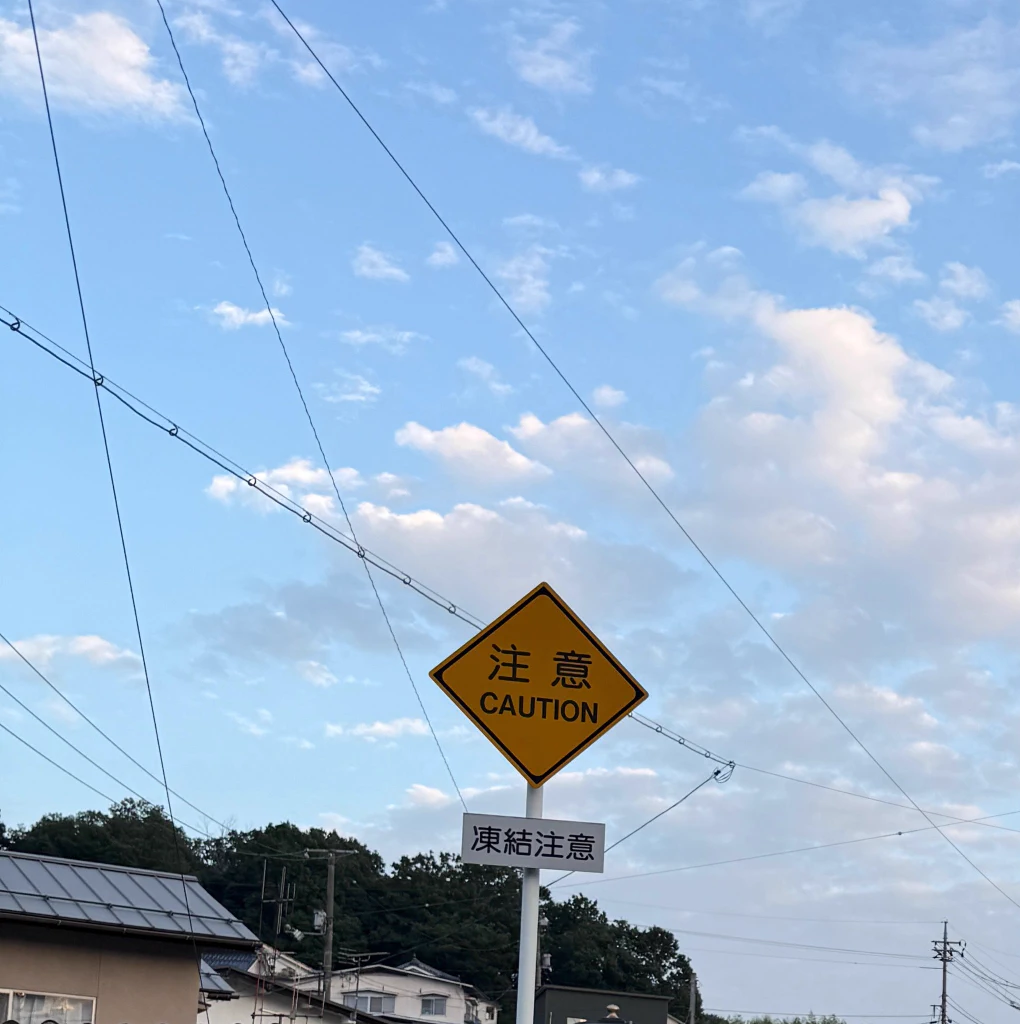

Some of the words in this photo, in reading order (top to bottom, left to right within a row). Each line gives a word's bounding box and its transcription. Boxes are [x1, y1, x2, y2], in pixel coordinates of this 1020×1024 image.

[479, 691, 599, 723] CAUTION
[470, 825, 596, 861] 凍結注意
